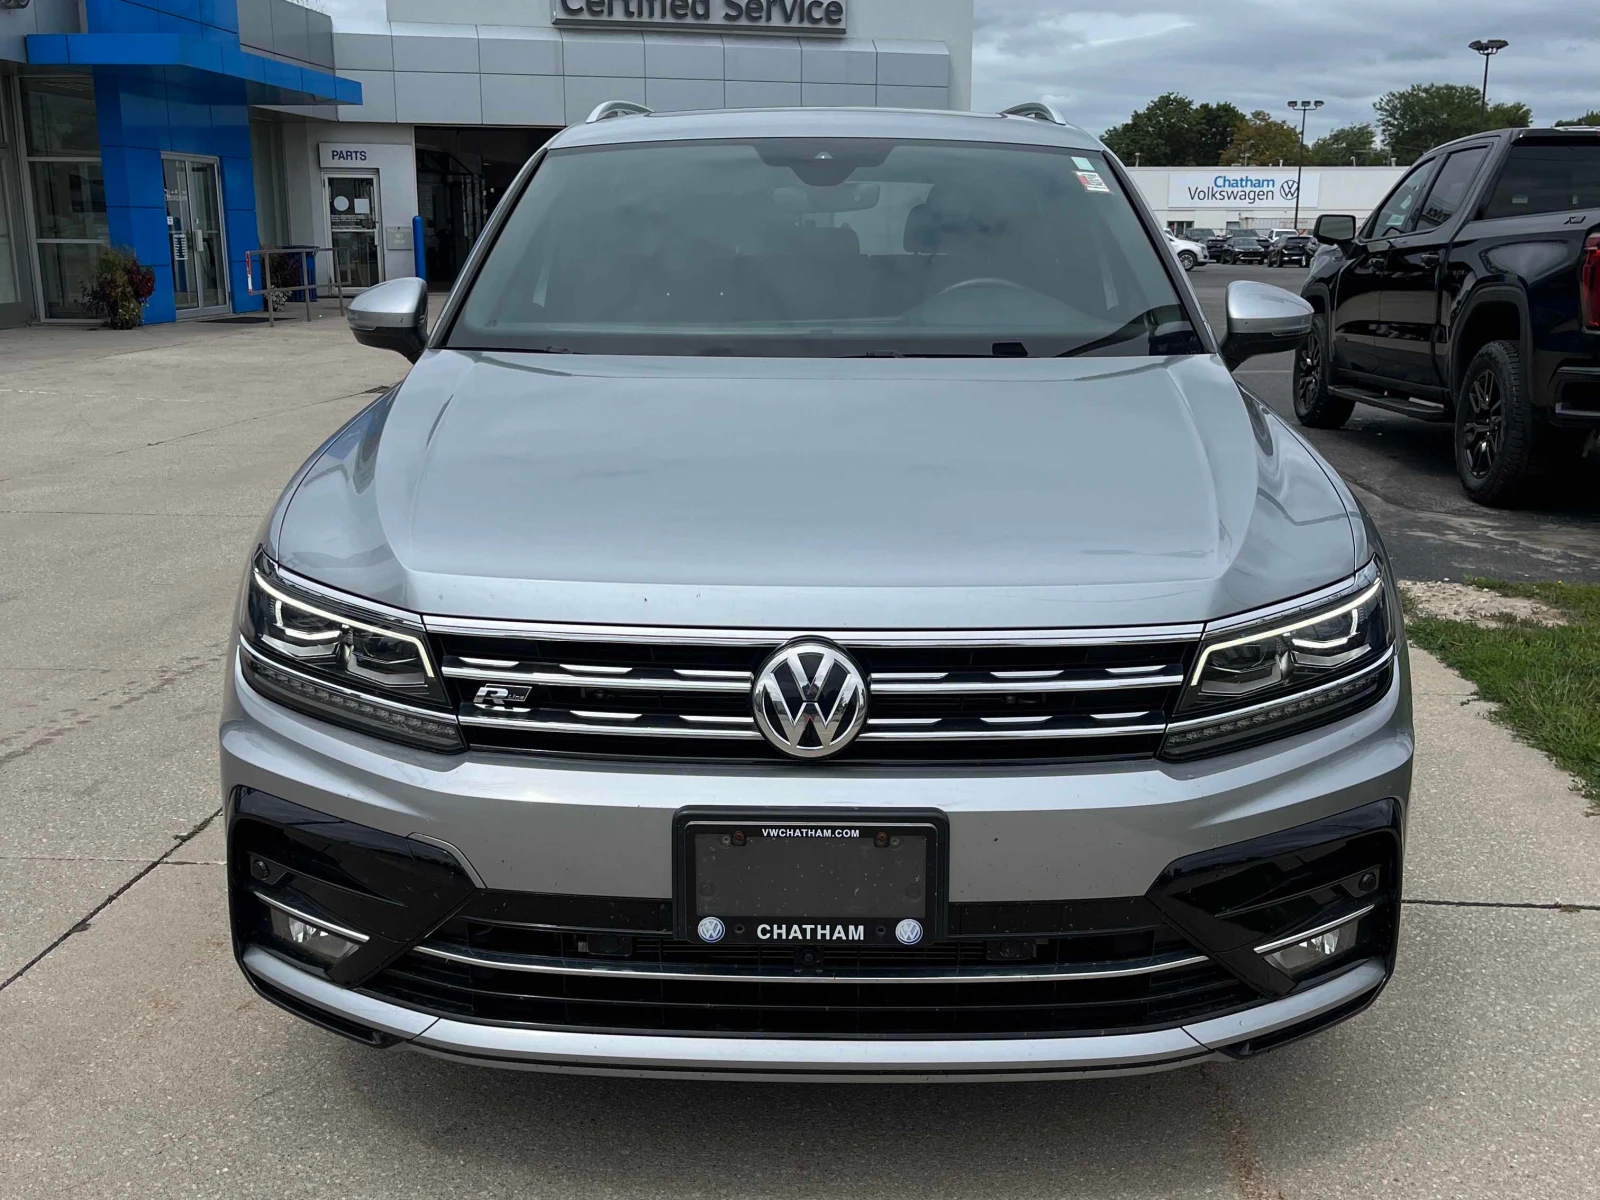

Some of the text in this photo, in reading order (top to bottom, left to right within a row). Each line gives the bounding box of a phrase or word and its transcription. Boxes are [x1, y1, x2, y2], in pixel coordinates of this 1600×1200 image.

[561, 0, 844, 25] Certified Service
[331, 150, 367, 161] PARTS
[1214, 175, 1275, 188] Chatham
[1188, 186, 1275, 204] Volkswagen
[761, 828, 860, 838] VWCHATHAM.COM
[756, 924, 865, 941] CHATHAM
